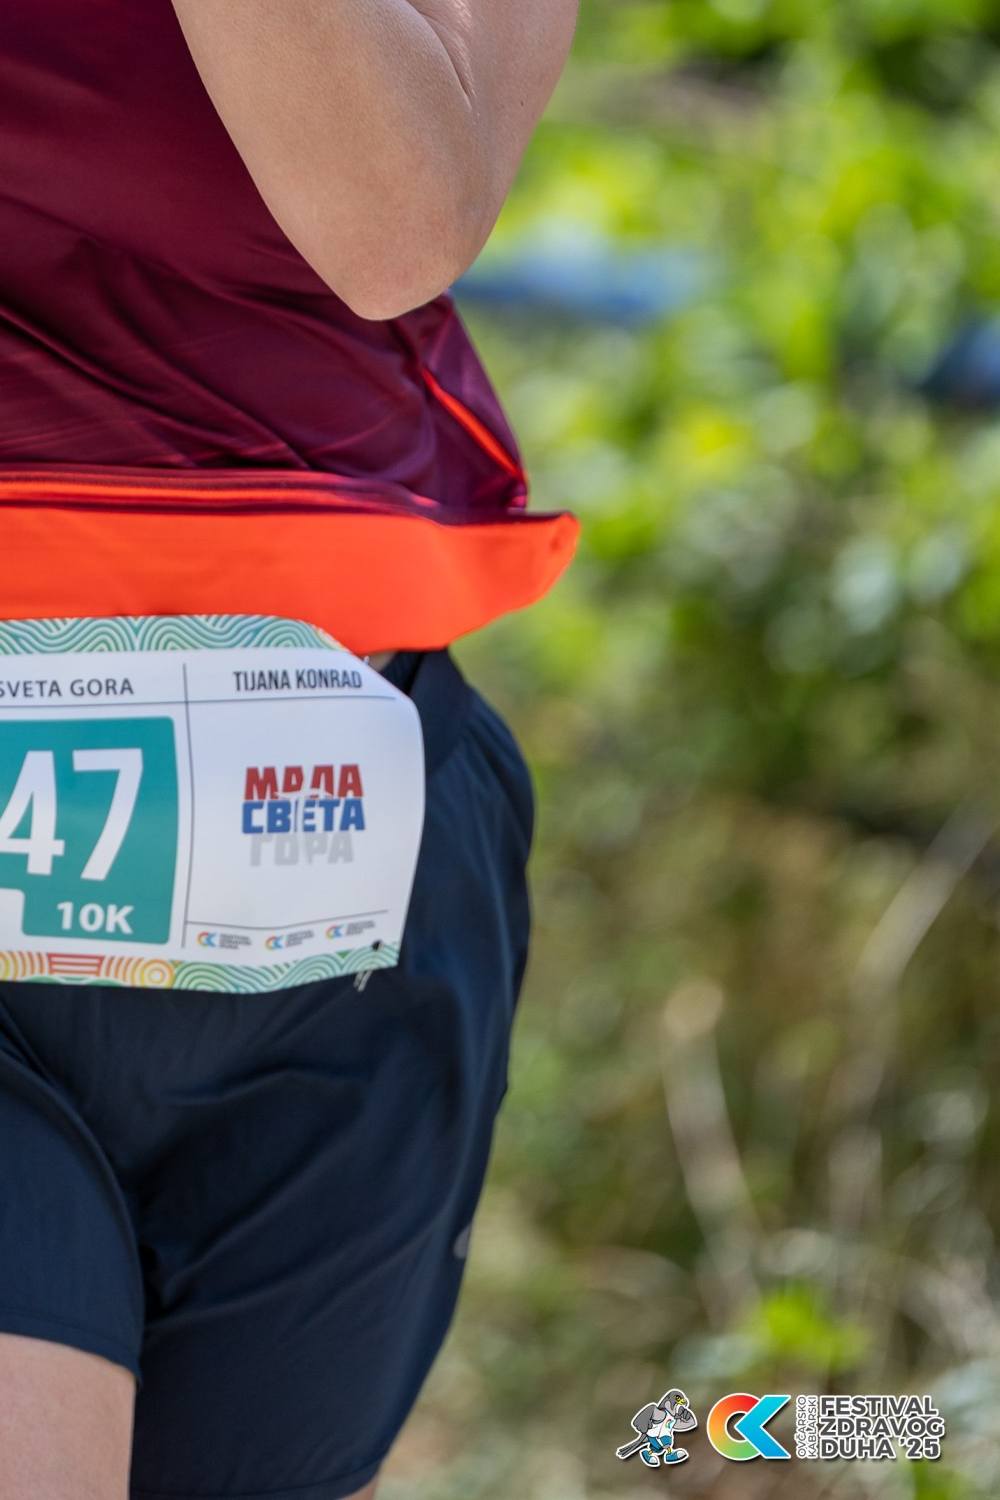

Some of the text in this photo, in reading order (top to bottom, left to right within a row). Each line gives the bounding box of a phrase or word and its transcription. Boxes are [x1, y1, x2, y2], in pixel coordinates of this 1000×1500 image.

[70, 678, 134, 696] GORA
[233, 668, 363, 692] TIJANA KONRAD
[57, 901, 134, 935] 10K
